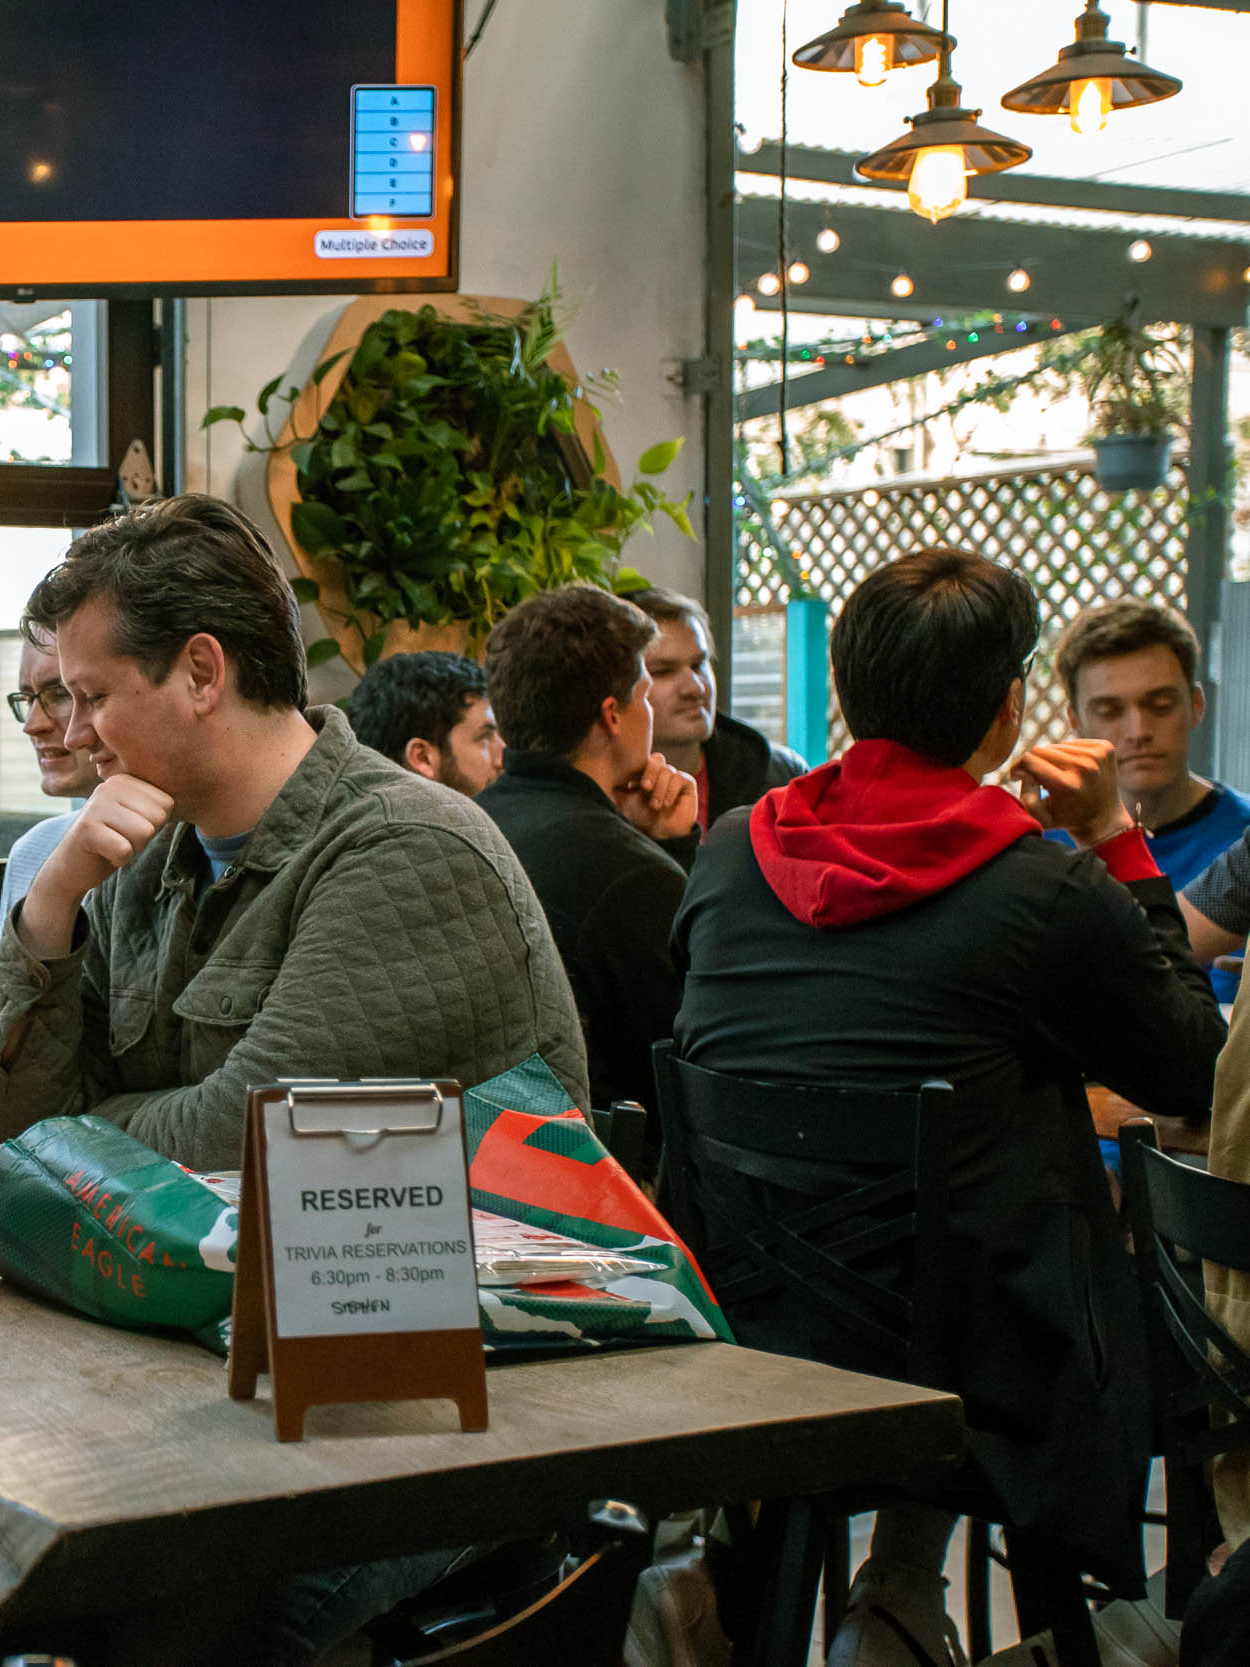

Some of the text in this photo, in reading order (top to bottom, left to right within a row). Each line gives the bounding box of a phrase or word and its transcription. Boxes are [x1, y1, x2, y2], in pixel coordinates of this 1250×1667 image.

[320, 237, 428, 254] Multiple Choice
[301, 1185, 444, 1212] RESERVED
[364, 1222, 383, 1238] for
[71, 1222, 147, 1297] EAGLE
[284, 1240, 468, 1262] TRIVIA RESERVATIONS
[311, 1269, 370, 1287] 6:30pm
[386, 1266, 444, 1285] 8:30pm
